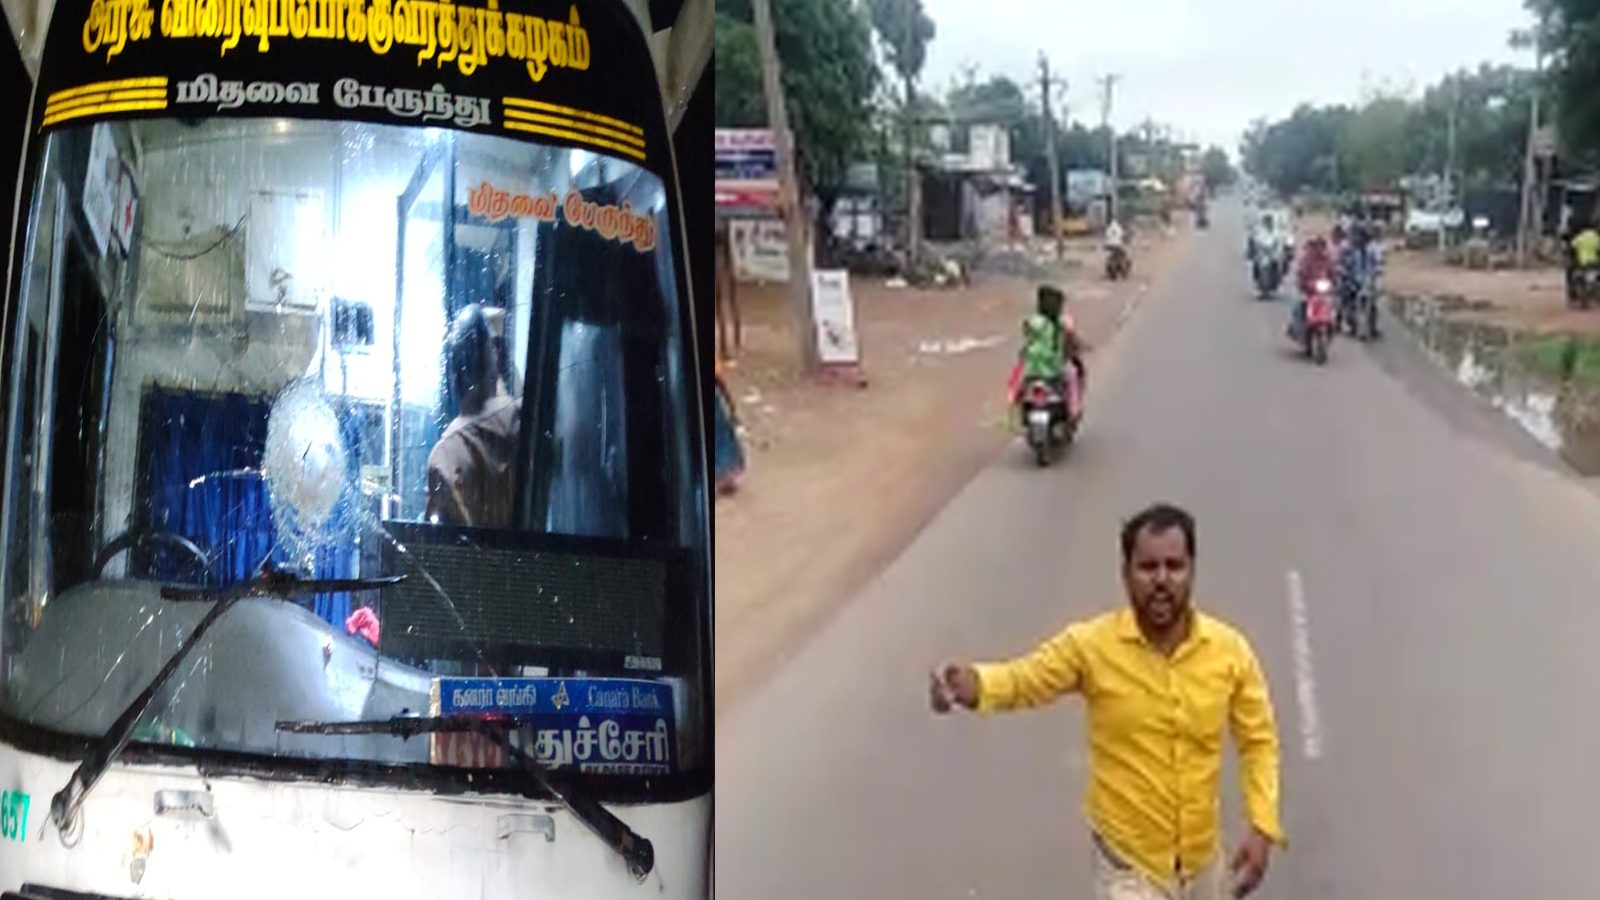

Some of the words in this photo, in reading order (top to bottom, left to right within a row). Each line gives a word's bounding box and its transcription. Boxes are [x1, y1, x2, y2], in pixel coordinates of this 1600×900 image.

[175, 73, 320, 112] மிதவை
[333, 78, 491, 127] பேருந்து
[469, 181, 557, 223] மிதவை
[563, 189, 656, 252] பேருந்து
[586, 685, 629, 707] Canara
[632, 686, 660, 709] Bank
[1, 789, 31, 842] 657
